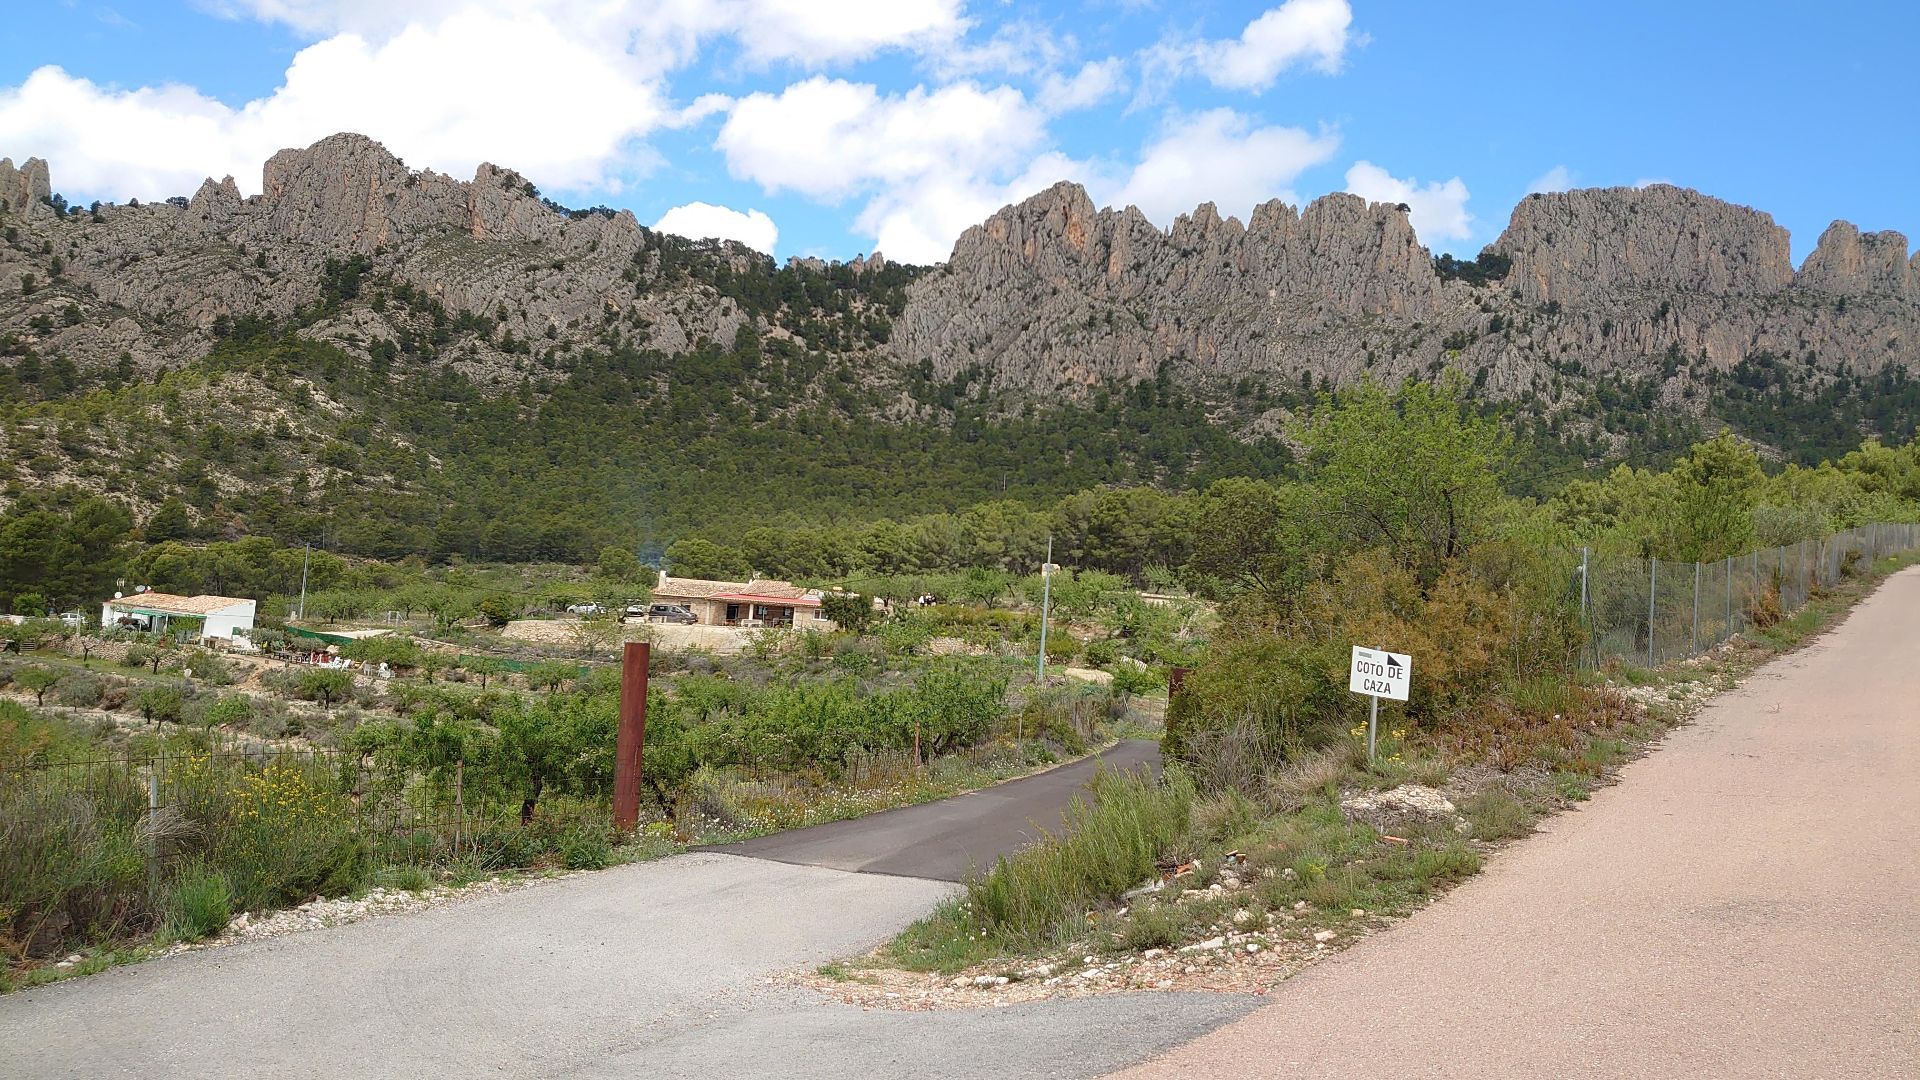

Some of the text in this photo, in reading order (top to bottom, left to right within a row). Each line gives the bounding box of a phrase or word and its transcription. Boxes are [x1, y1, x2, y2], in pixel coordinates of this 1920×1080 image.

[1357, 660, 1403, 680] COTO DE
[1363, 678, 1391, 694] CAZA
